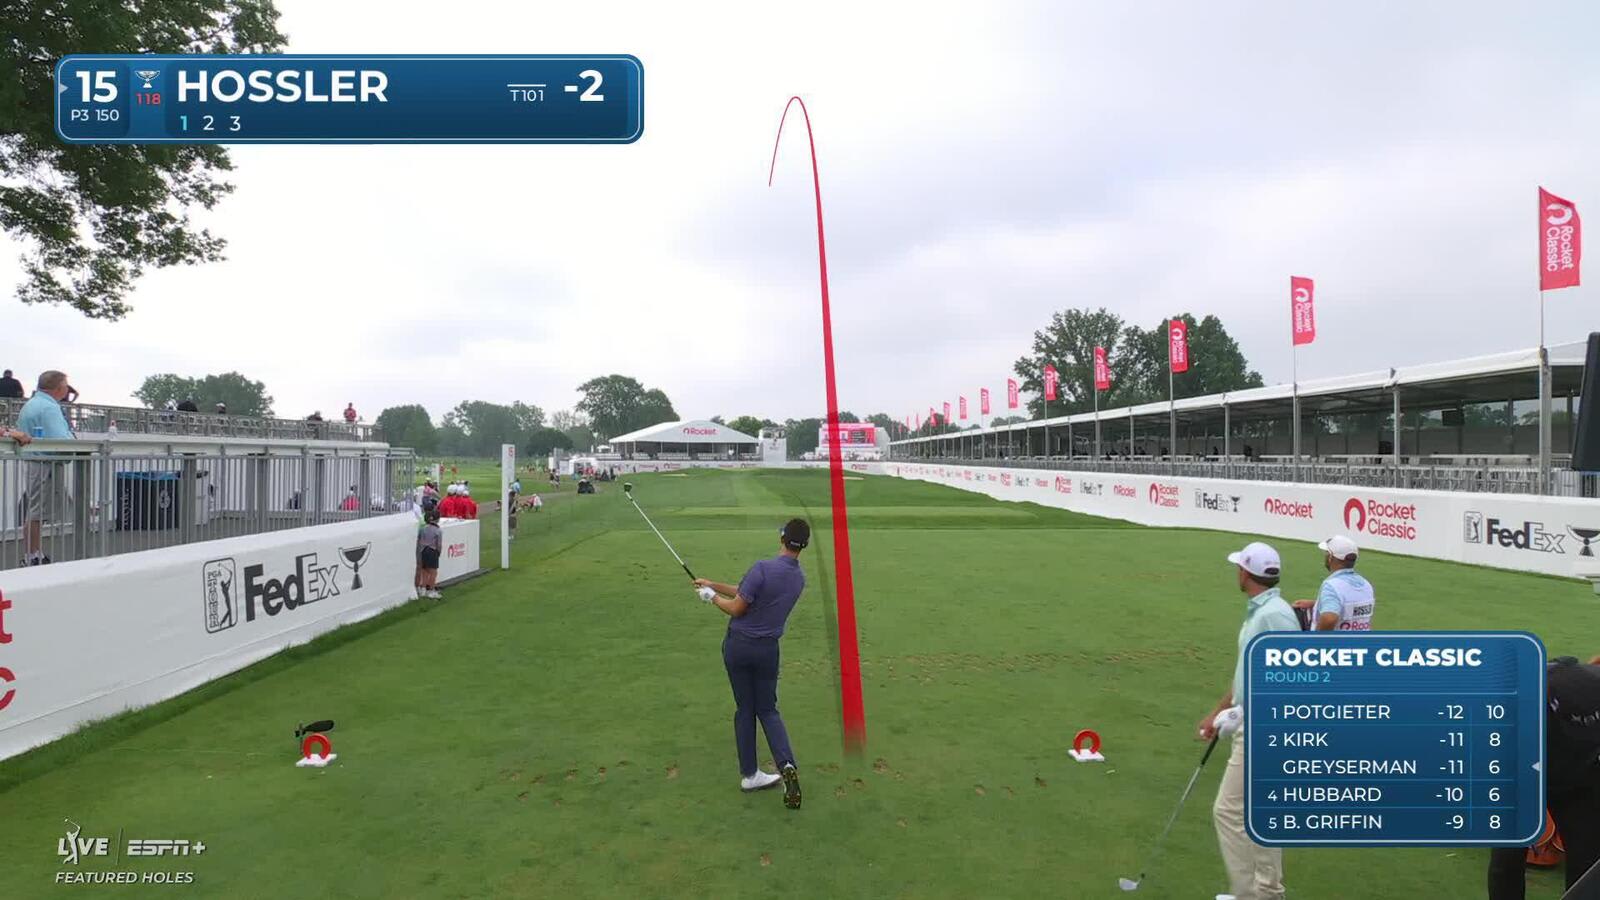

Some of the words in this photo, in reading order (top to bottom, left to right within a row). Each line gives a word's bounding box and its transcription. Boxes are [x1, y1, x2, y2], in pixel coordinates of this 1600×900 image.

[1546, 226, 1560, 272] Classic
[1560, 225, 1574, 270] Rocket
[1274, 499, 1313, 519] Rocket
[1368, 499, 1416, 521] Rocket
[1368, 517, 1416, 540] Classic
[1487, 518, 1566, 554] FedEx
[244, 552, 340, 623] FedEx
